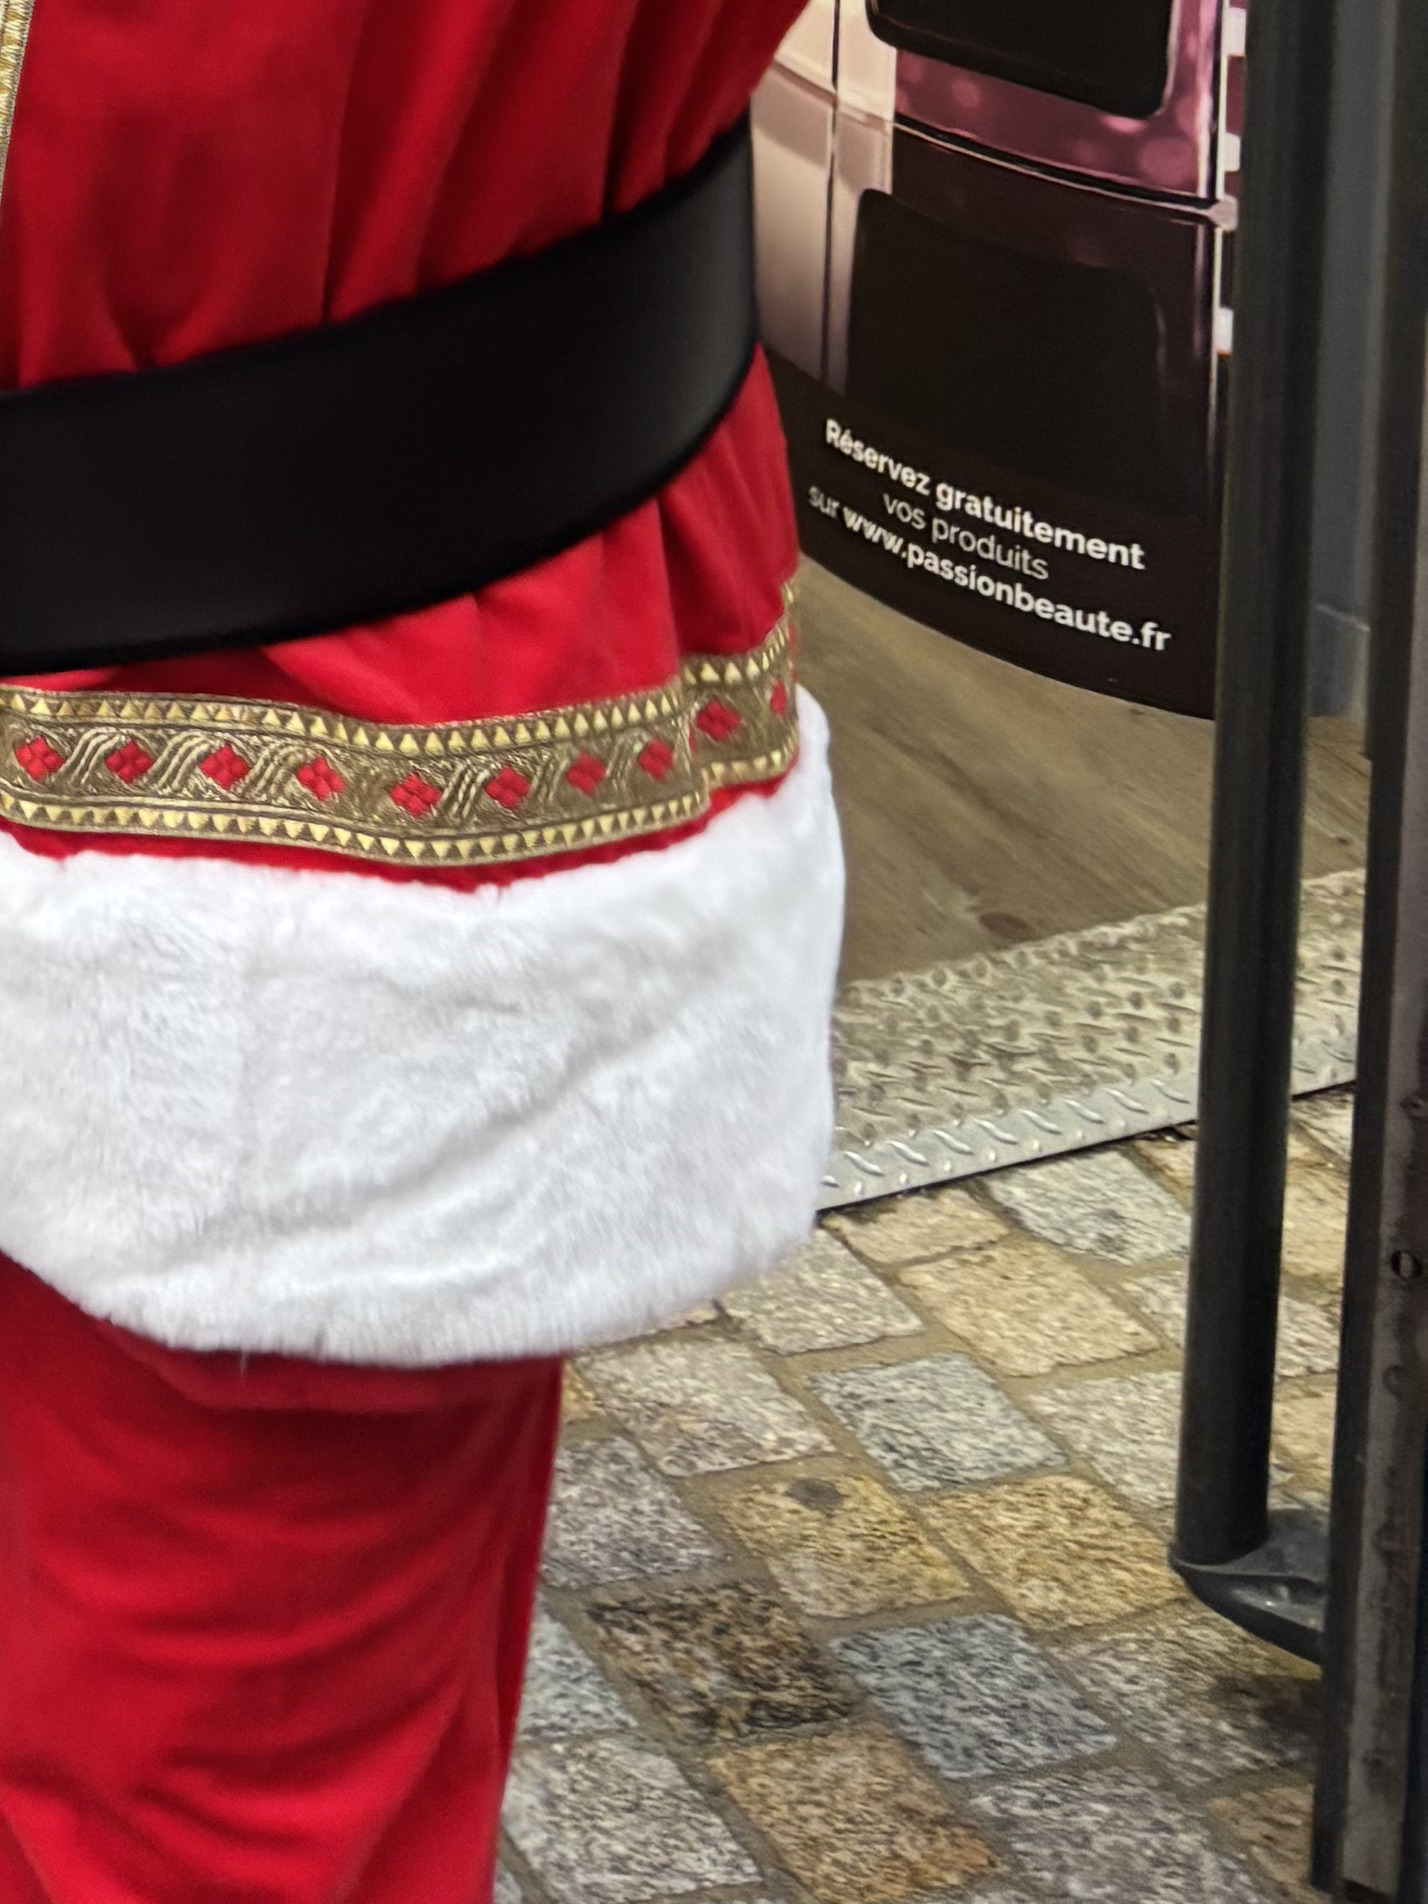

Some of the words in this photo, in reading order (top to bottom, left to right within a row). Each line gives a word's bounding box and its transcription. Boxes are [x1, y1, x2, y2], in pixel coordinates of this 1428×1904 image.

[806, 485, 841, 519] sur
[842, 505, 1172, 653] www.passionbeaute.fr
[825, 418, 931, 496] Réservez
[935, 482, 1147, 571] gratuitement
[882, 493, 926, 530] vos
[931, 517, 1049, 581] produits
